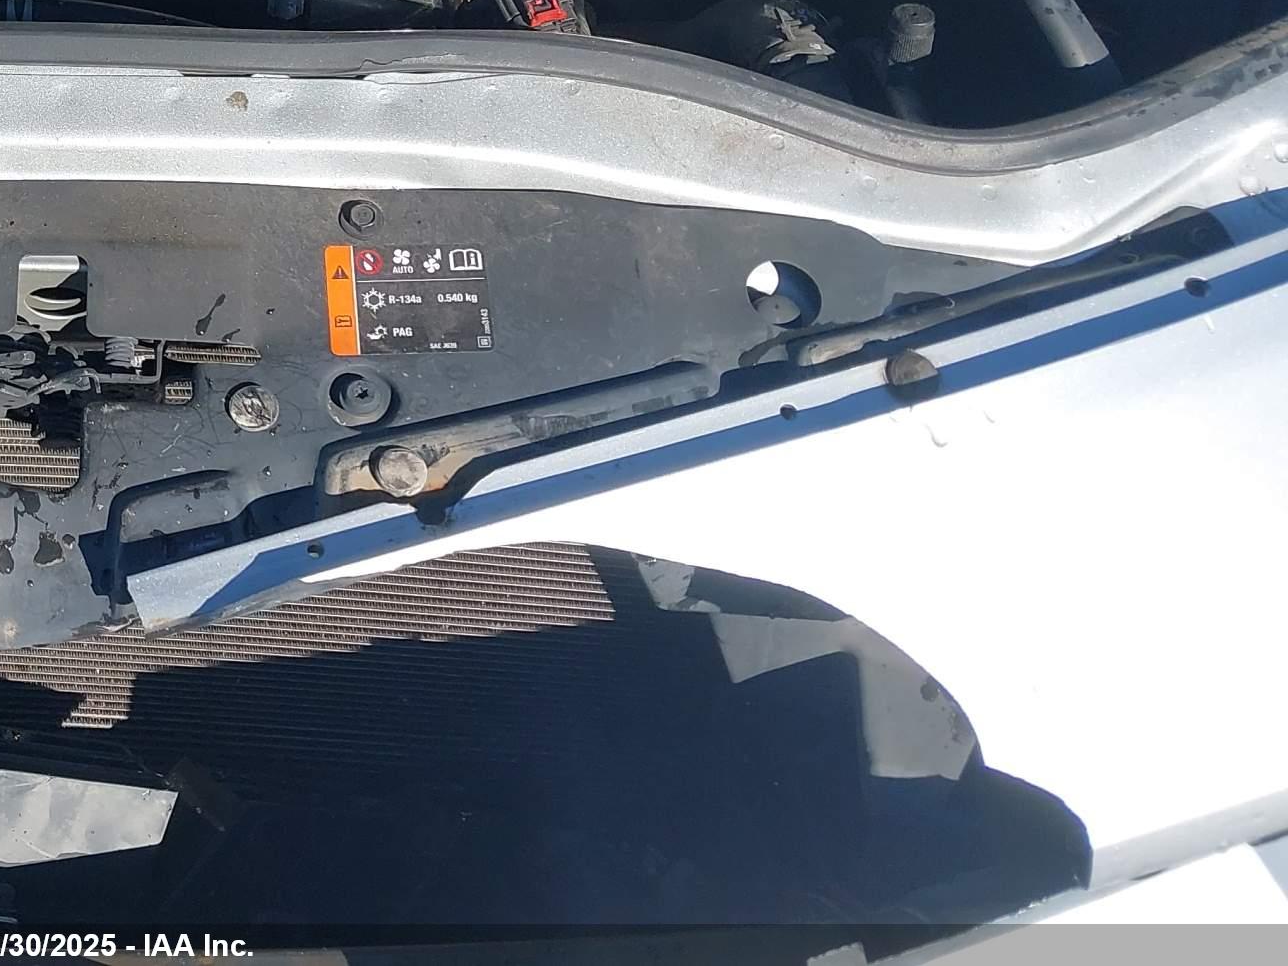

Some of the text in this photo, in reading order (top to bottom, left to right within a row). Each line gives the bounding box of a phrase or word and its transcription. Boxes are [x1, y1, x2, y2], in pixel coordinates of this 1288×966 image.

[392, 265, 414, 274] AUTO
[388, 294, 423, 304] R-134a
[437, 292, 478, 304] 0.540 kg
[392, 327, 414, 338] PAG
